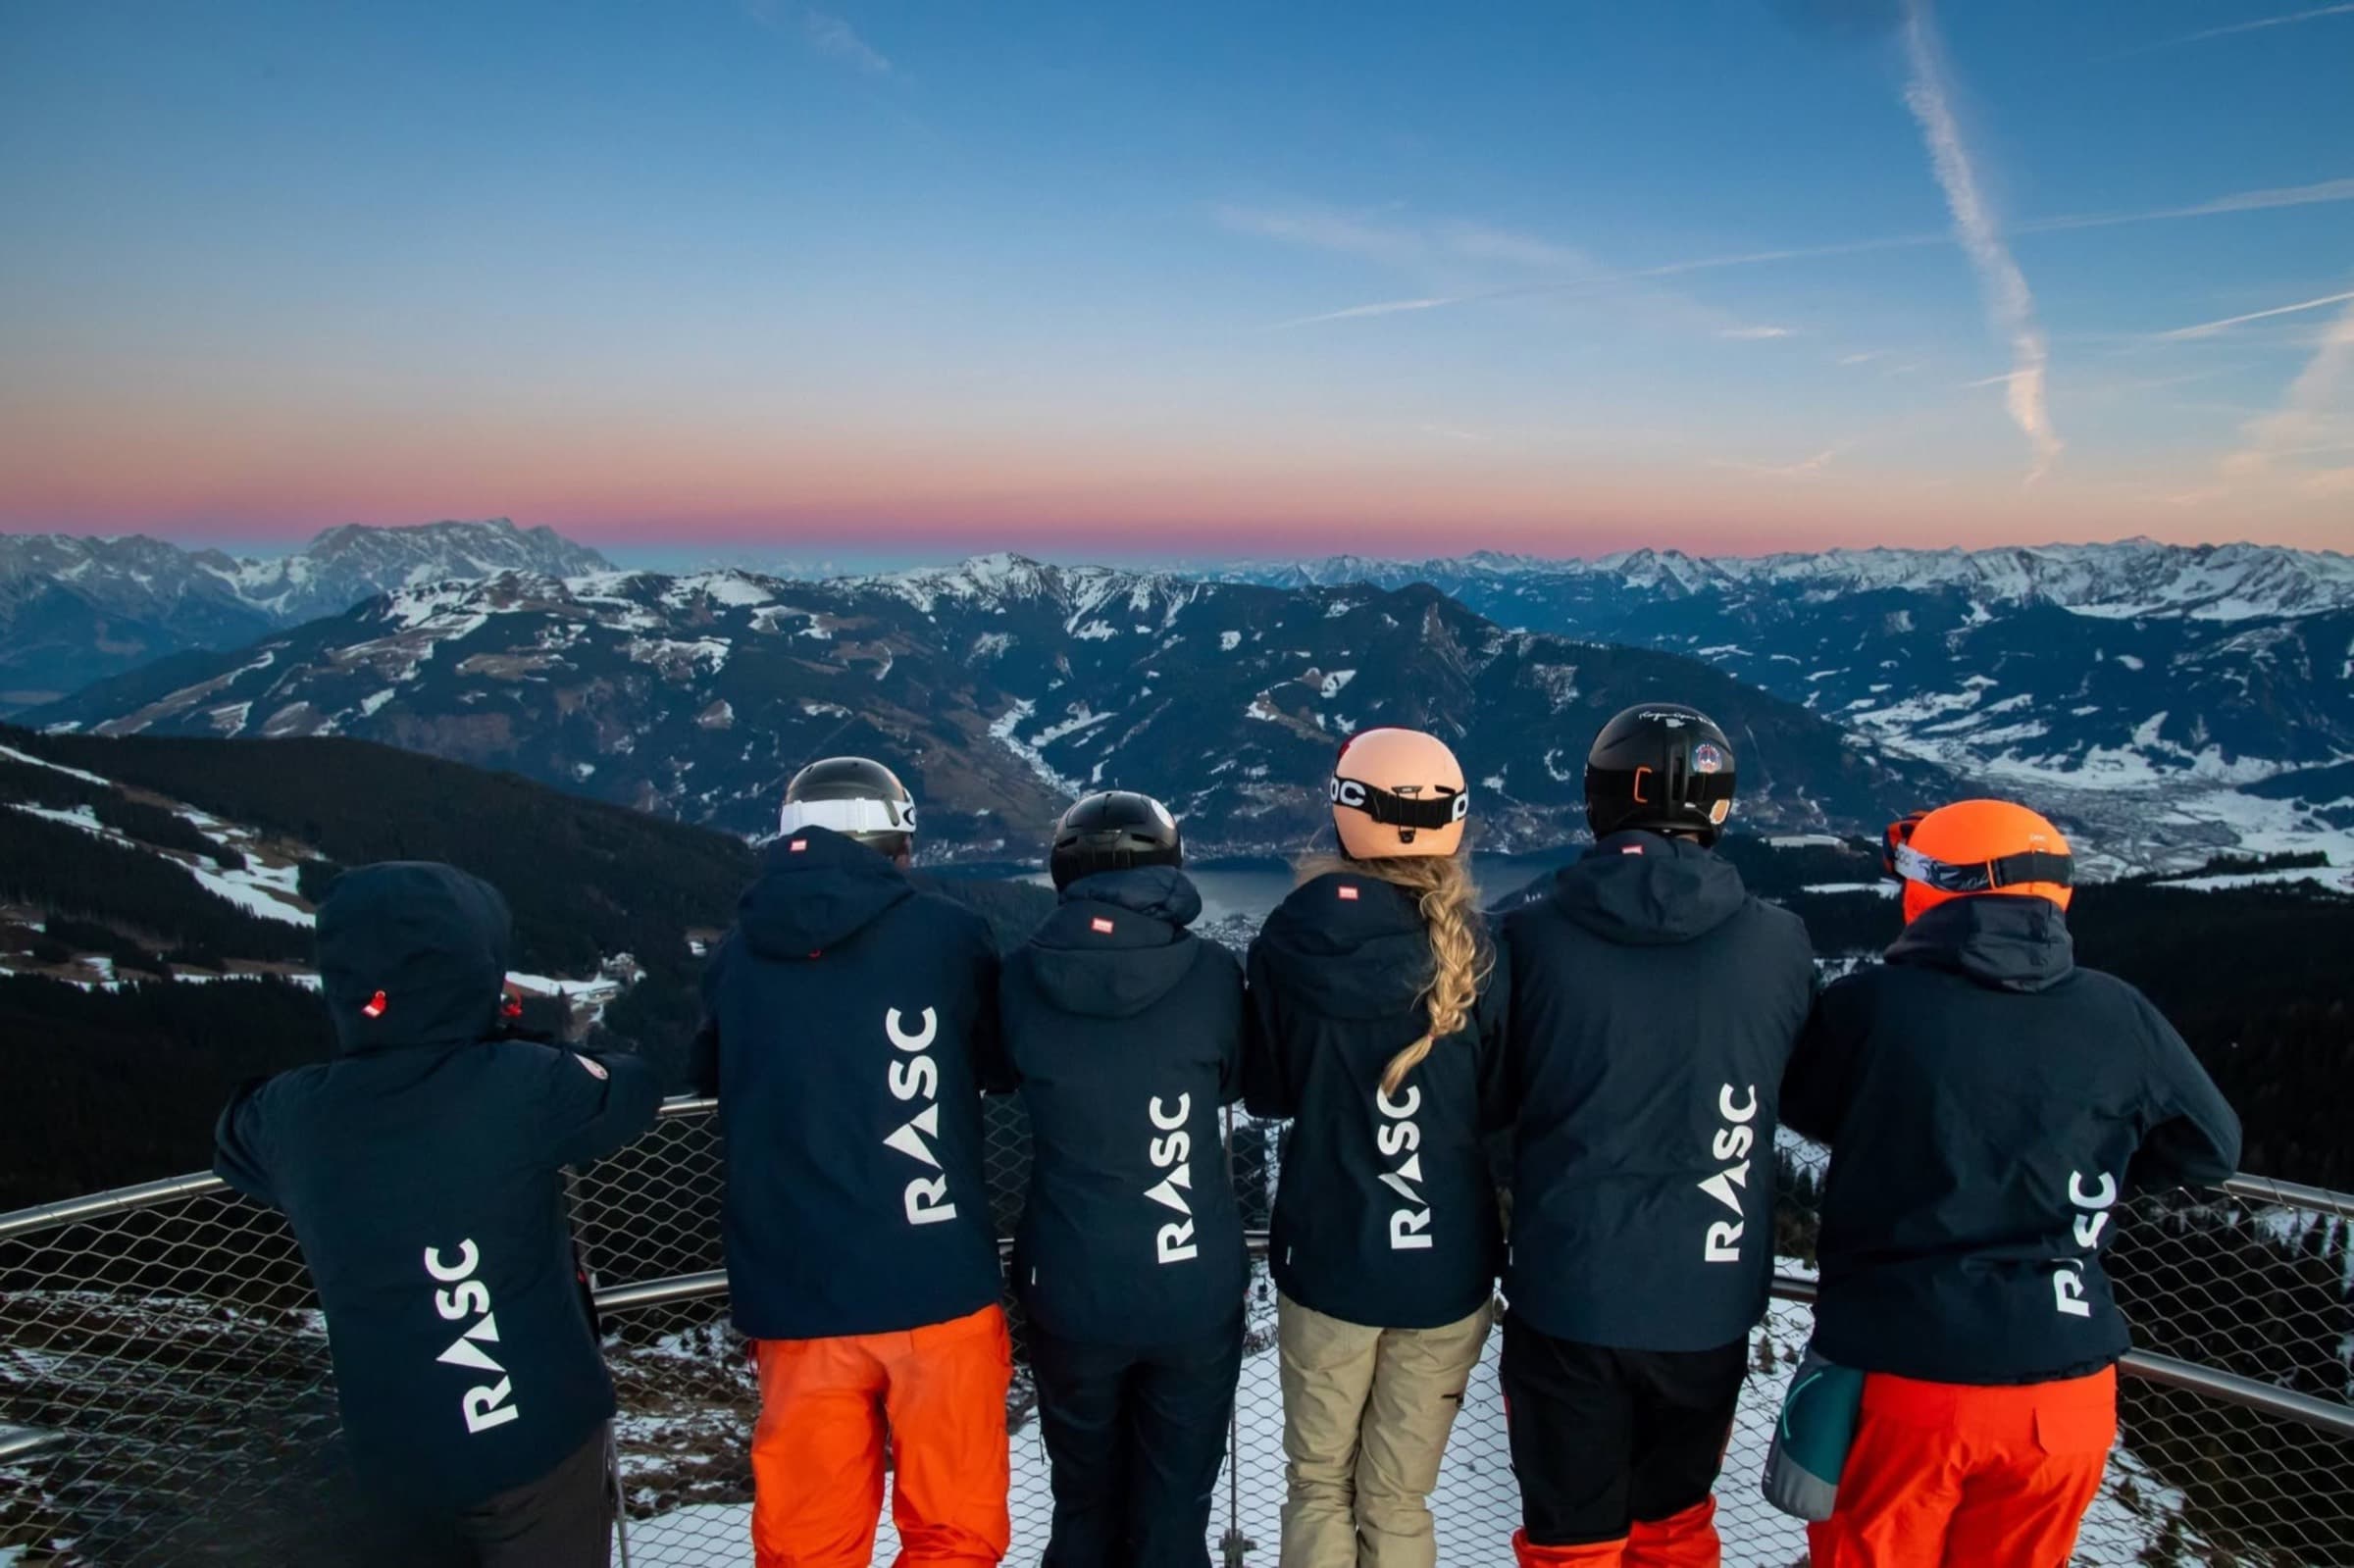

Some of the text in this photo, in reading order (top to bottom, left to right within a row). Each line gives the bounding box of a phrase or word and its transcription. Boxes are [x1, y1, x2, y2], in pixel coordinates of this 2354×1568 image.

[883, 1007, 957, 1225] RASC
[1143, 1092, 1198, 1264] RASC
[1377, 1084, 1433, 1249] RASC
[1697, 1083, 1758, 1262] RASC
[2052, 1170, 2117, 1318] RSC
[424, 1239, 519, 1434] RASC
